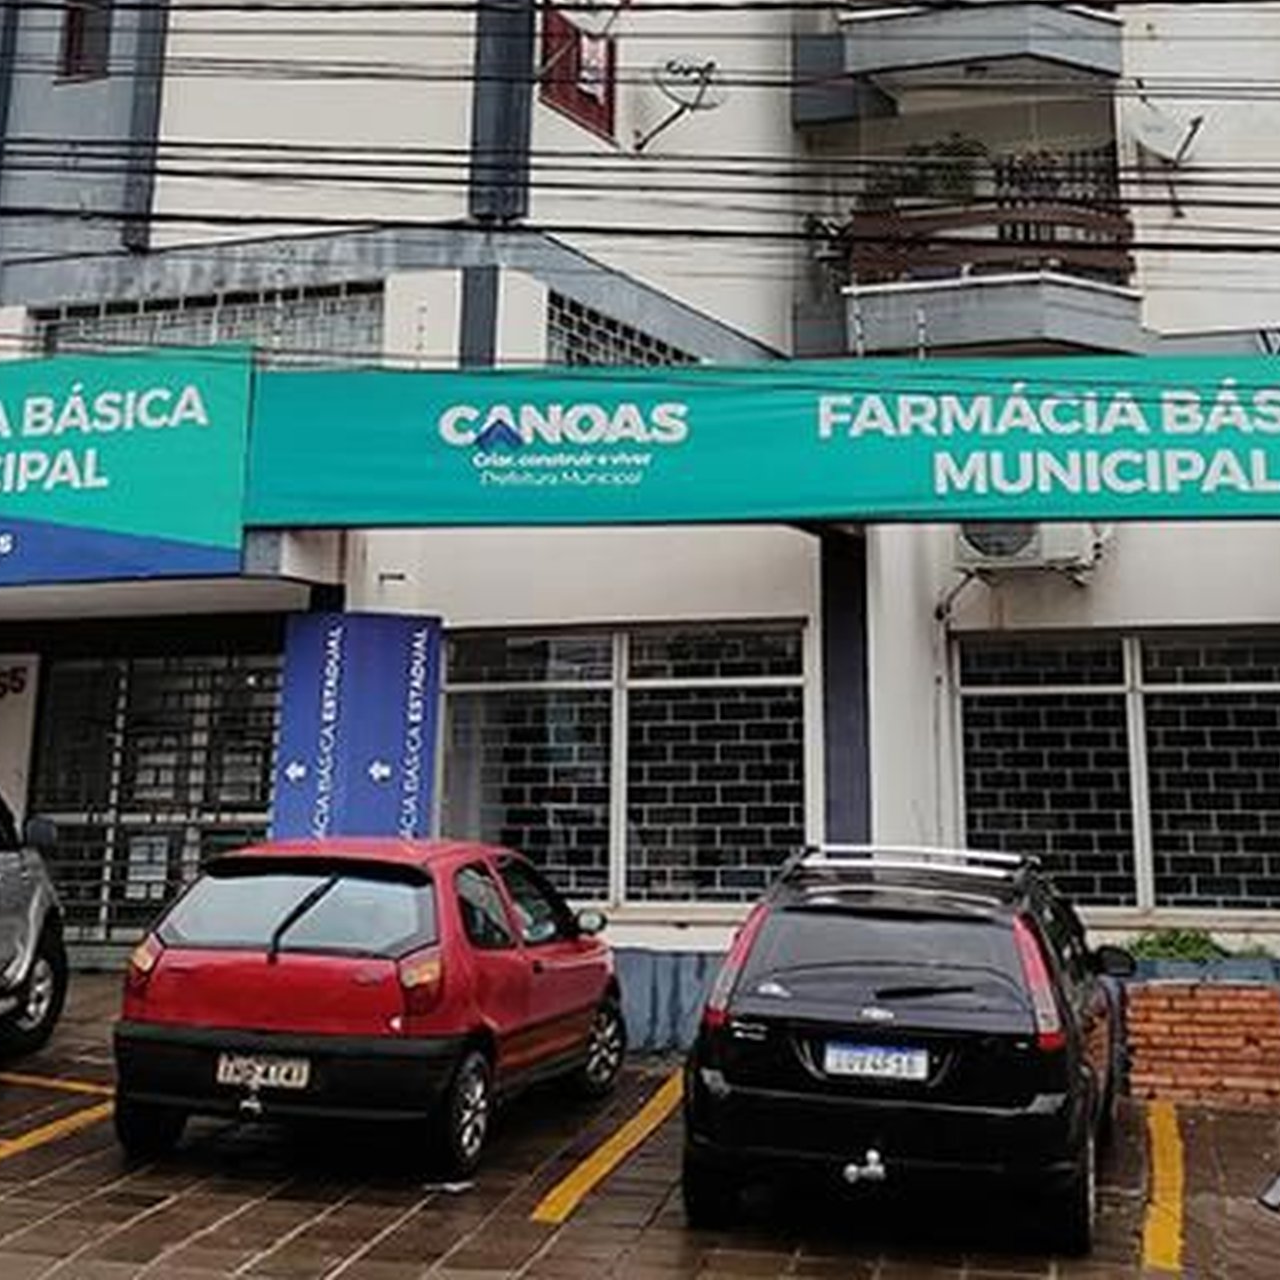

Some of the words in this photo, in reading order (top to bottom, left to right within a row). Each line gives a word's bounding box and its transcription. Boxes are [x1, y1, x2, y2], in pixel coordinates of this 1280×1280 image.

[23, 383, 208, 437] BÁSICA
[438, 403, 689, 447] CANOAS
[818, 381, 1150, 437] FARMÁCIA
[322, 625, 344, 722] ESTADUAL
[407, 627, 429, 723] ESTADUAL
